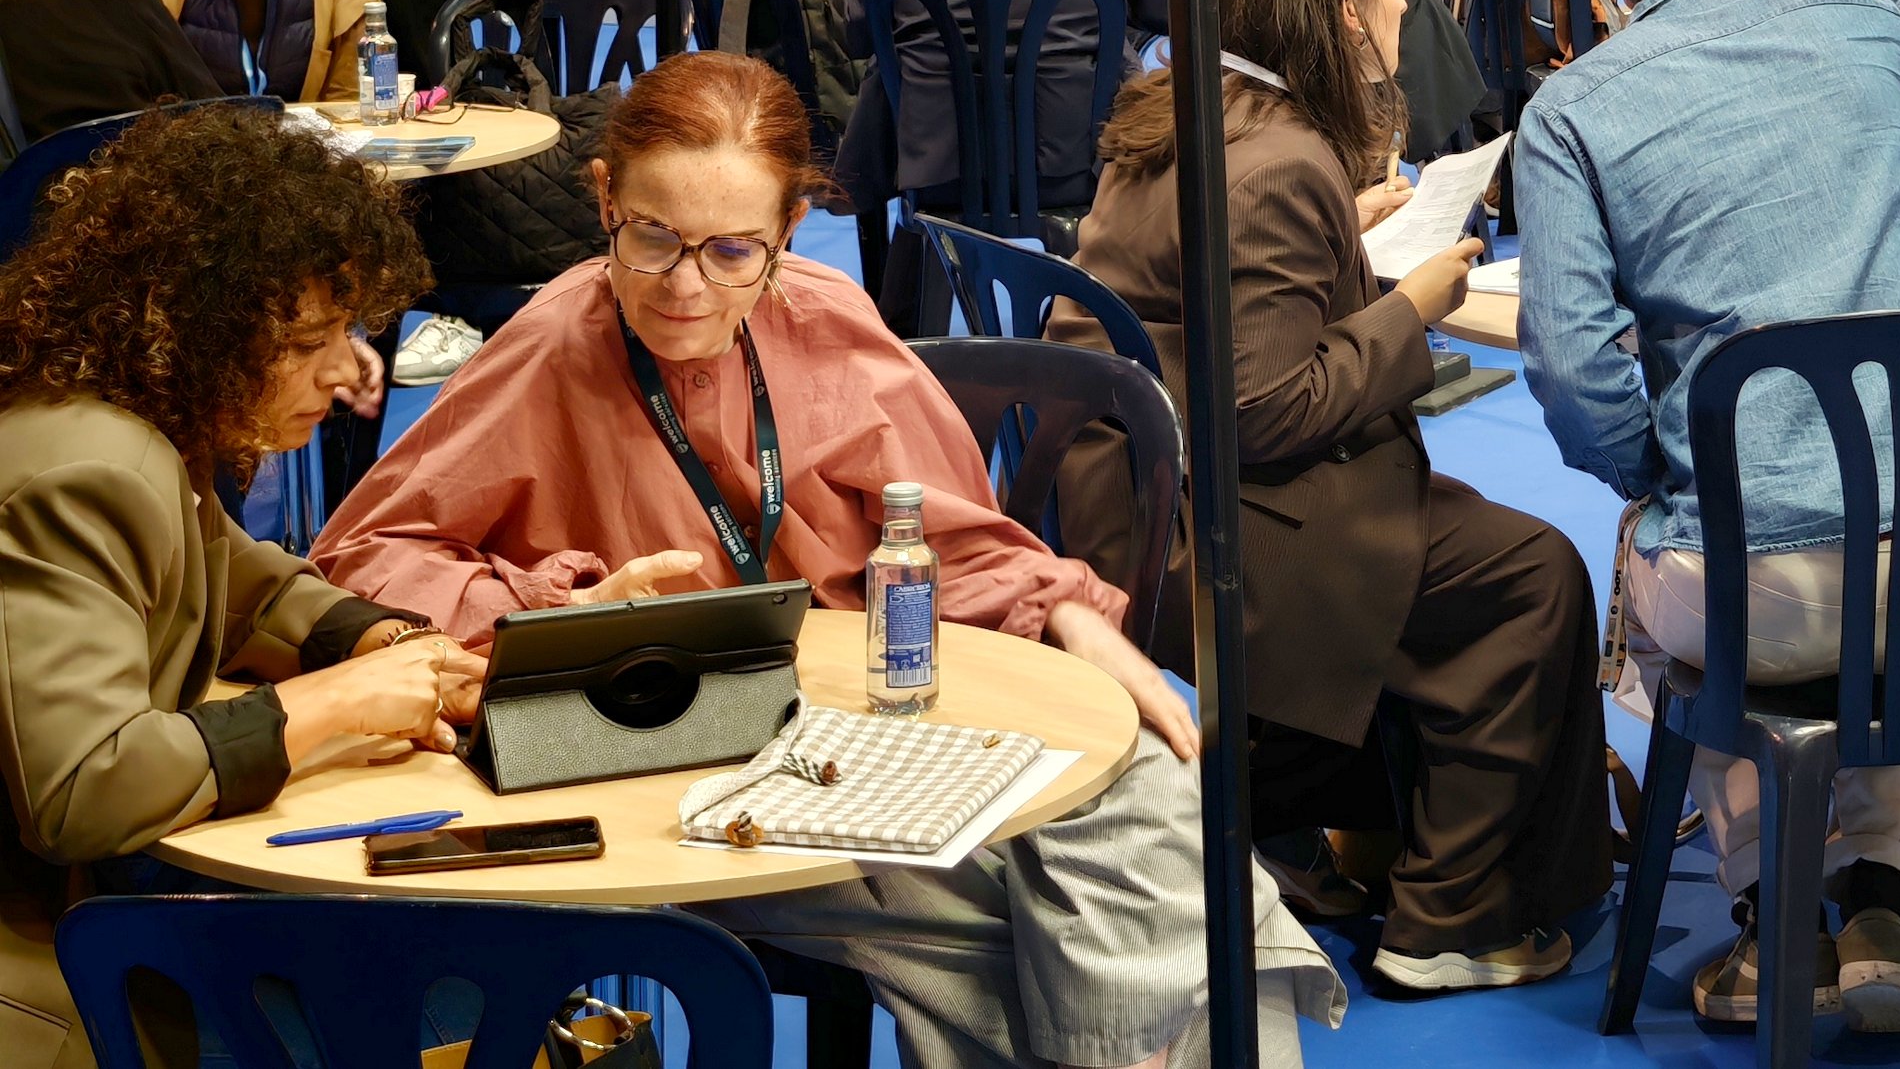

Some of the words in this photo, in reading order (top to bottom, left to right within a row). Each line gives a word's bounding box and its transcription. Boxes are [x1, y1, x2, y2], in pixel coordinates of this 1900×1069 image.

[650, 394, 683, 447] welcome
[761, 449, 775, 504] welcome
[709, 504, 742, 558] welcome
